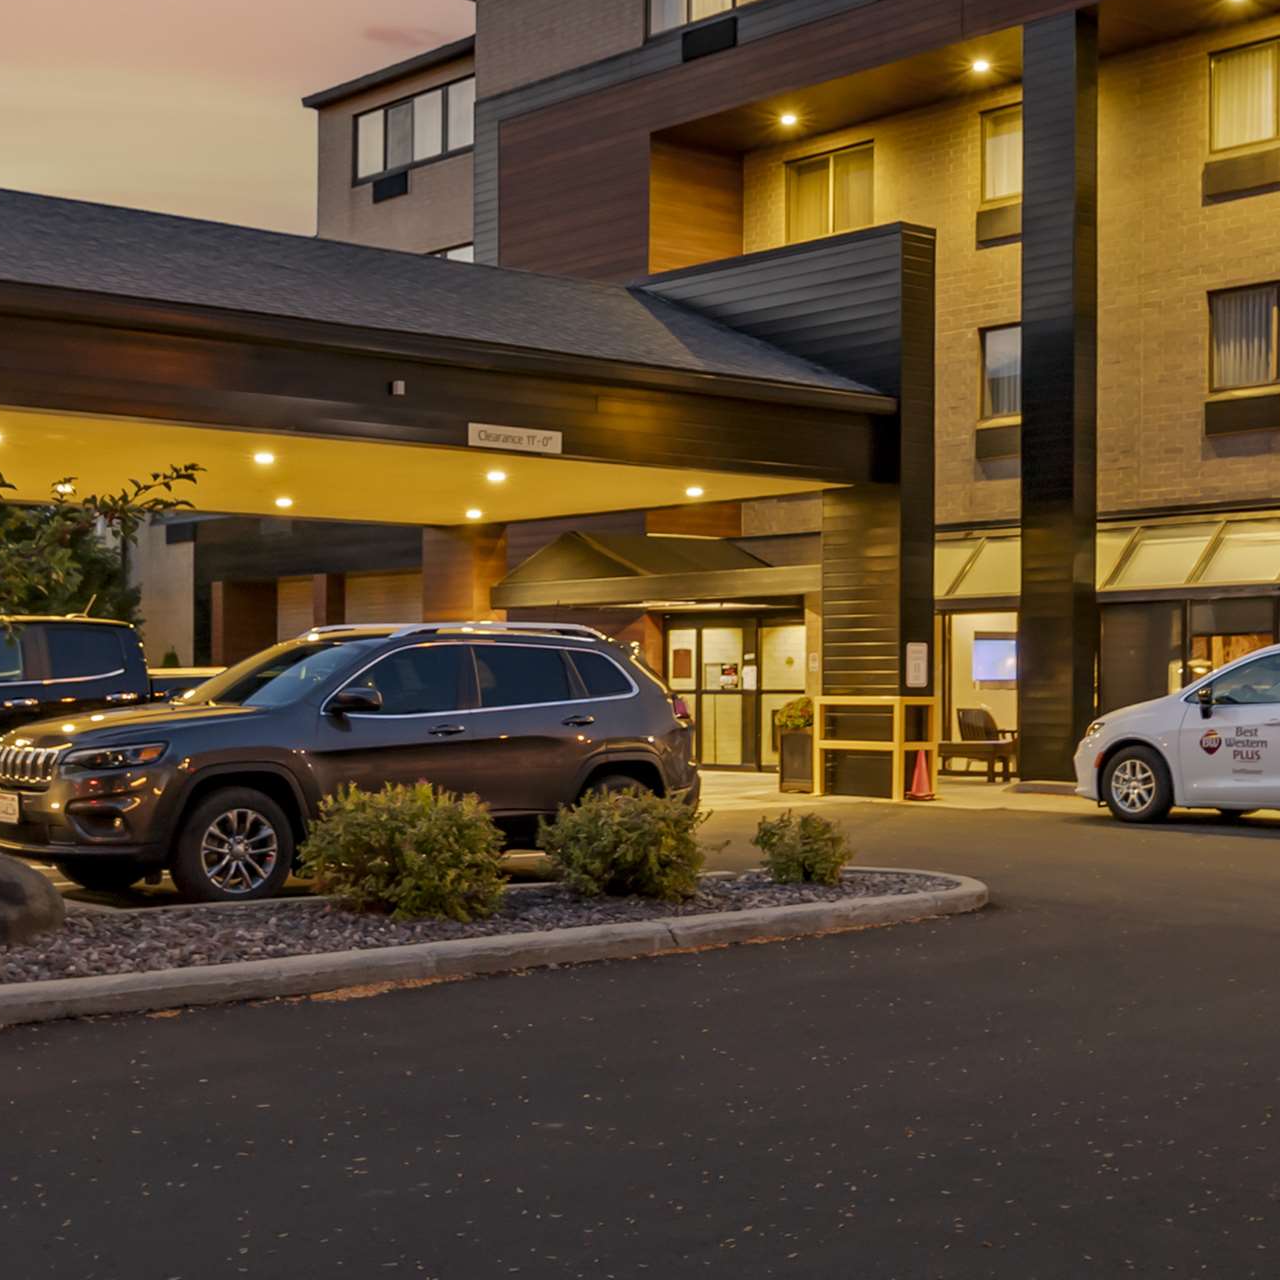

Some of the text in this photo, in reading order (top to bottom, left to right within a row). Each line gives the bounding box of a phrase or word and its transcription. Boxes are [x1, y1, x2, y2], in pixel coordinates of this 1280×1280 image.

[478, 429, 524, 446] Clearance
[1235, 726, 1259, 738] Best
[1224, 738, 1268, 749] Western
[1232, 749, 1261, 761] PLUS
